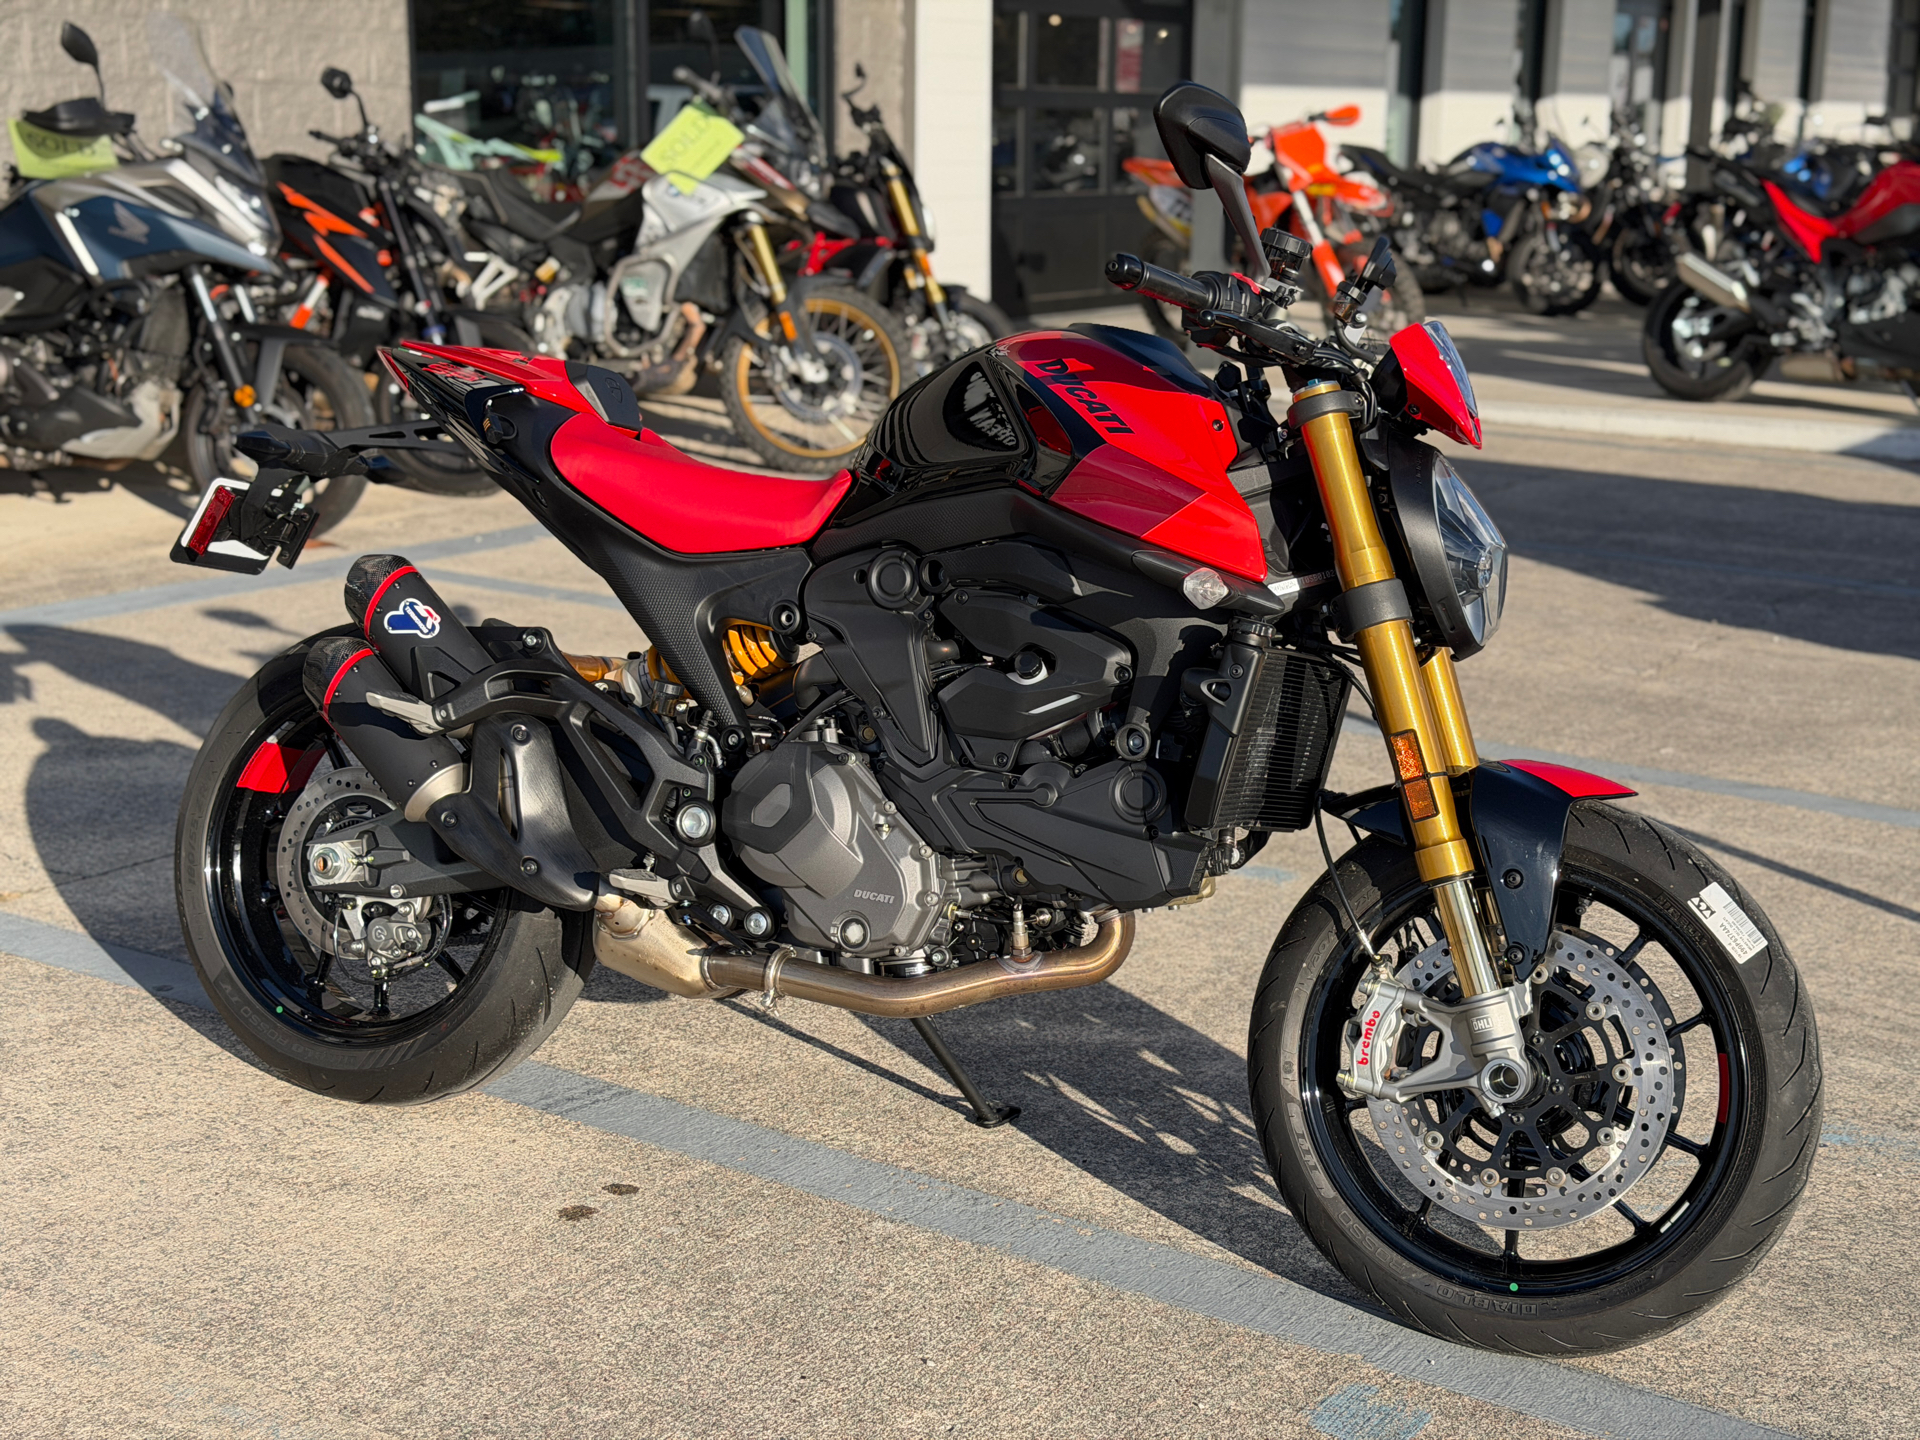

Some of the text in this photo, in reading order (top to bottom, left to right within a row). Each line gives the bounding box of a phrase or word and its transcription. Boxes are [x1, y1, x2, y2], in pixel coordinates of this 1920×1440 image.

[1034, 358, 1136, 435] DUCATI
[853, 889, 895, 904] DUCATI
[1357, 1010, 1381, 1066] brembo
[1338, 1210, 1538, 1316] DIABLO ROSSO
